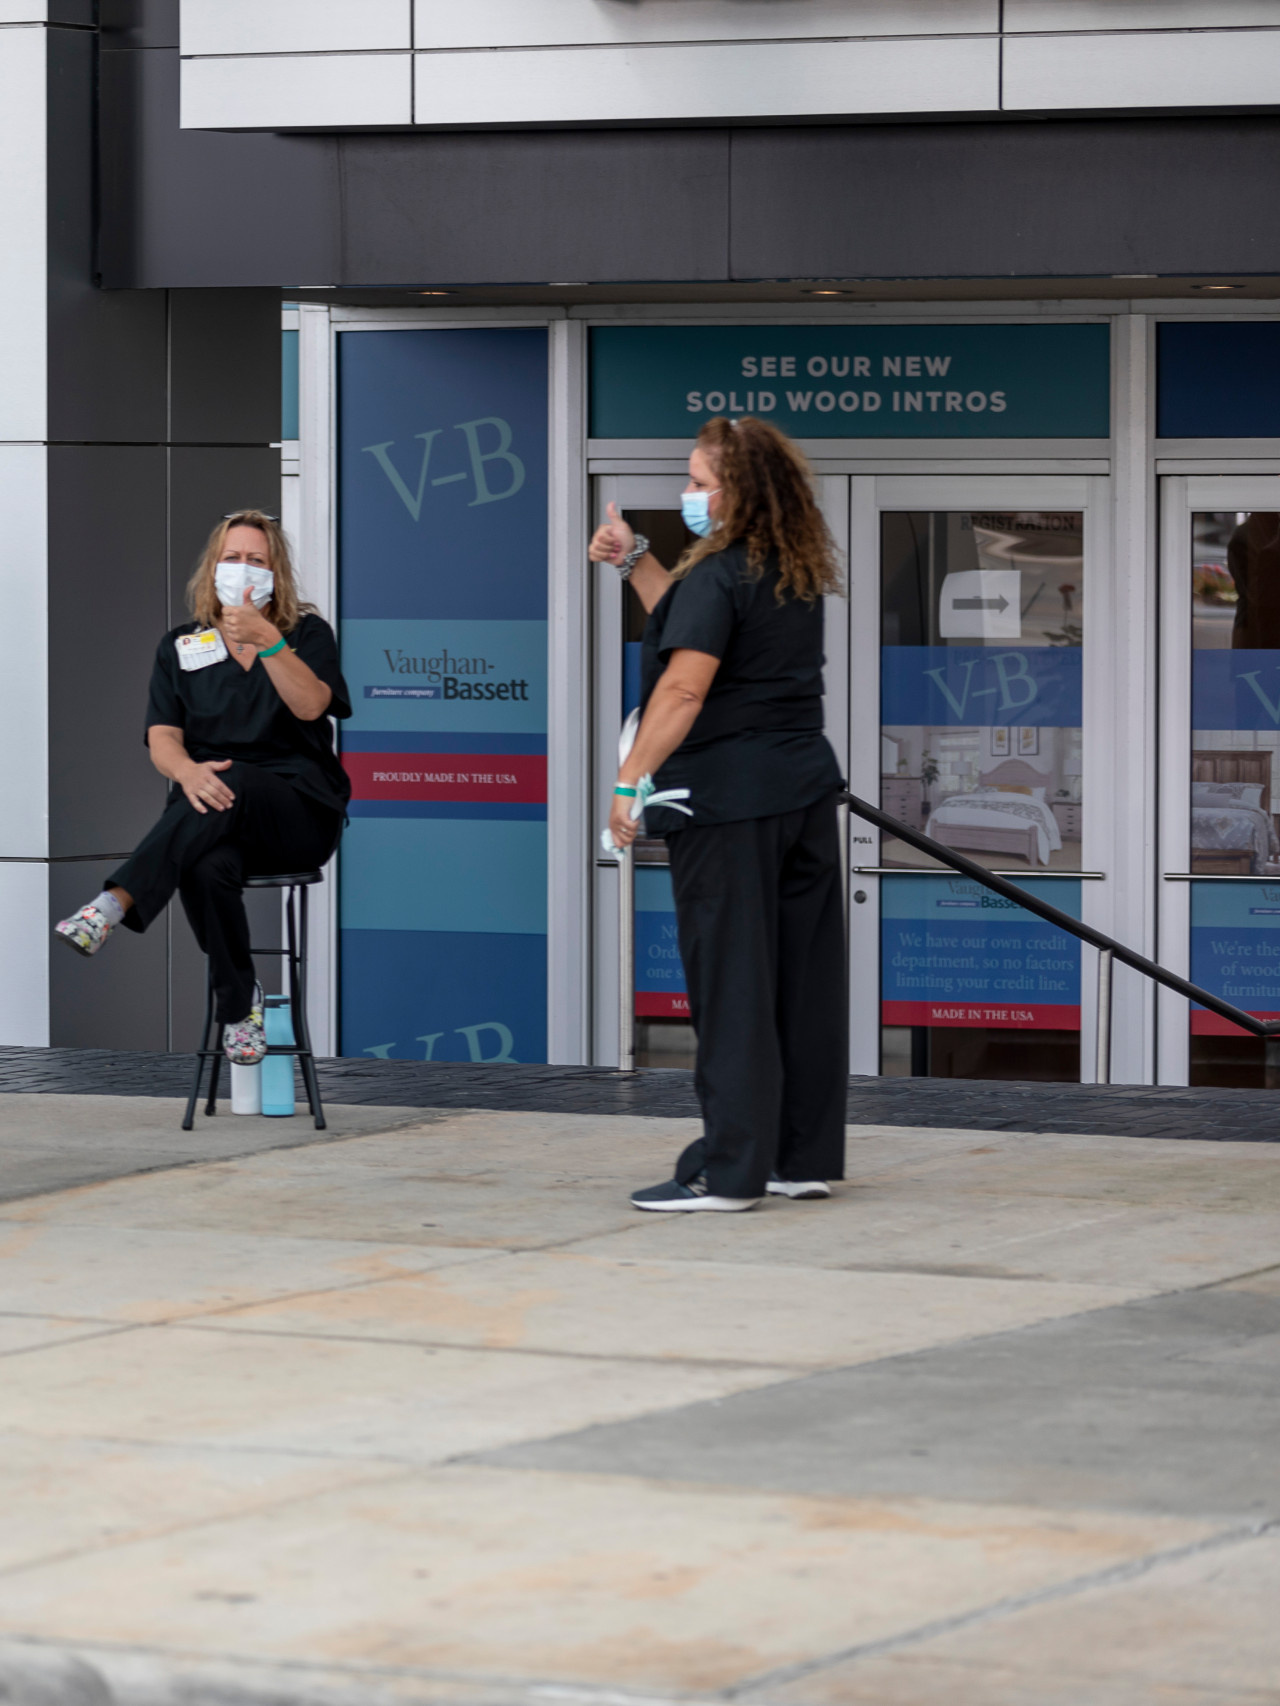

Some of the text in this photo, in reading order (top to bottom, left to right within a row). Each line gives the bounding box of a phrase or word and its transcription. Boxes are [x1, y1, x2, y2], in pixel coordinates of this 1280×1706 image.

[740, 355, 952, 378] SEE OUR NEW
[686, 390, 1008, 413] SOLID WOOD INTROS
[442, 677, 529, 701] Bassett
[372, 771, 518, 784] PROUDLY MADE IN THE USA
[899, 932, 1068, 951] We have our own credit
[1210, 940, 1253, 956] We're
[891, 951, 1075, 971] department, so no factors
[1220, 960, 1239, 976] of
[647, 967, 673, 979] one
[896, 972, 1070, 993] limiting your credit line.
[932, 1008, 1035, 1021] MADE IN THE USA
